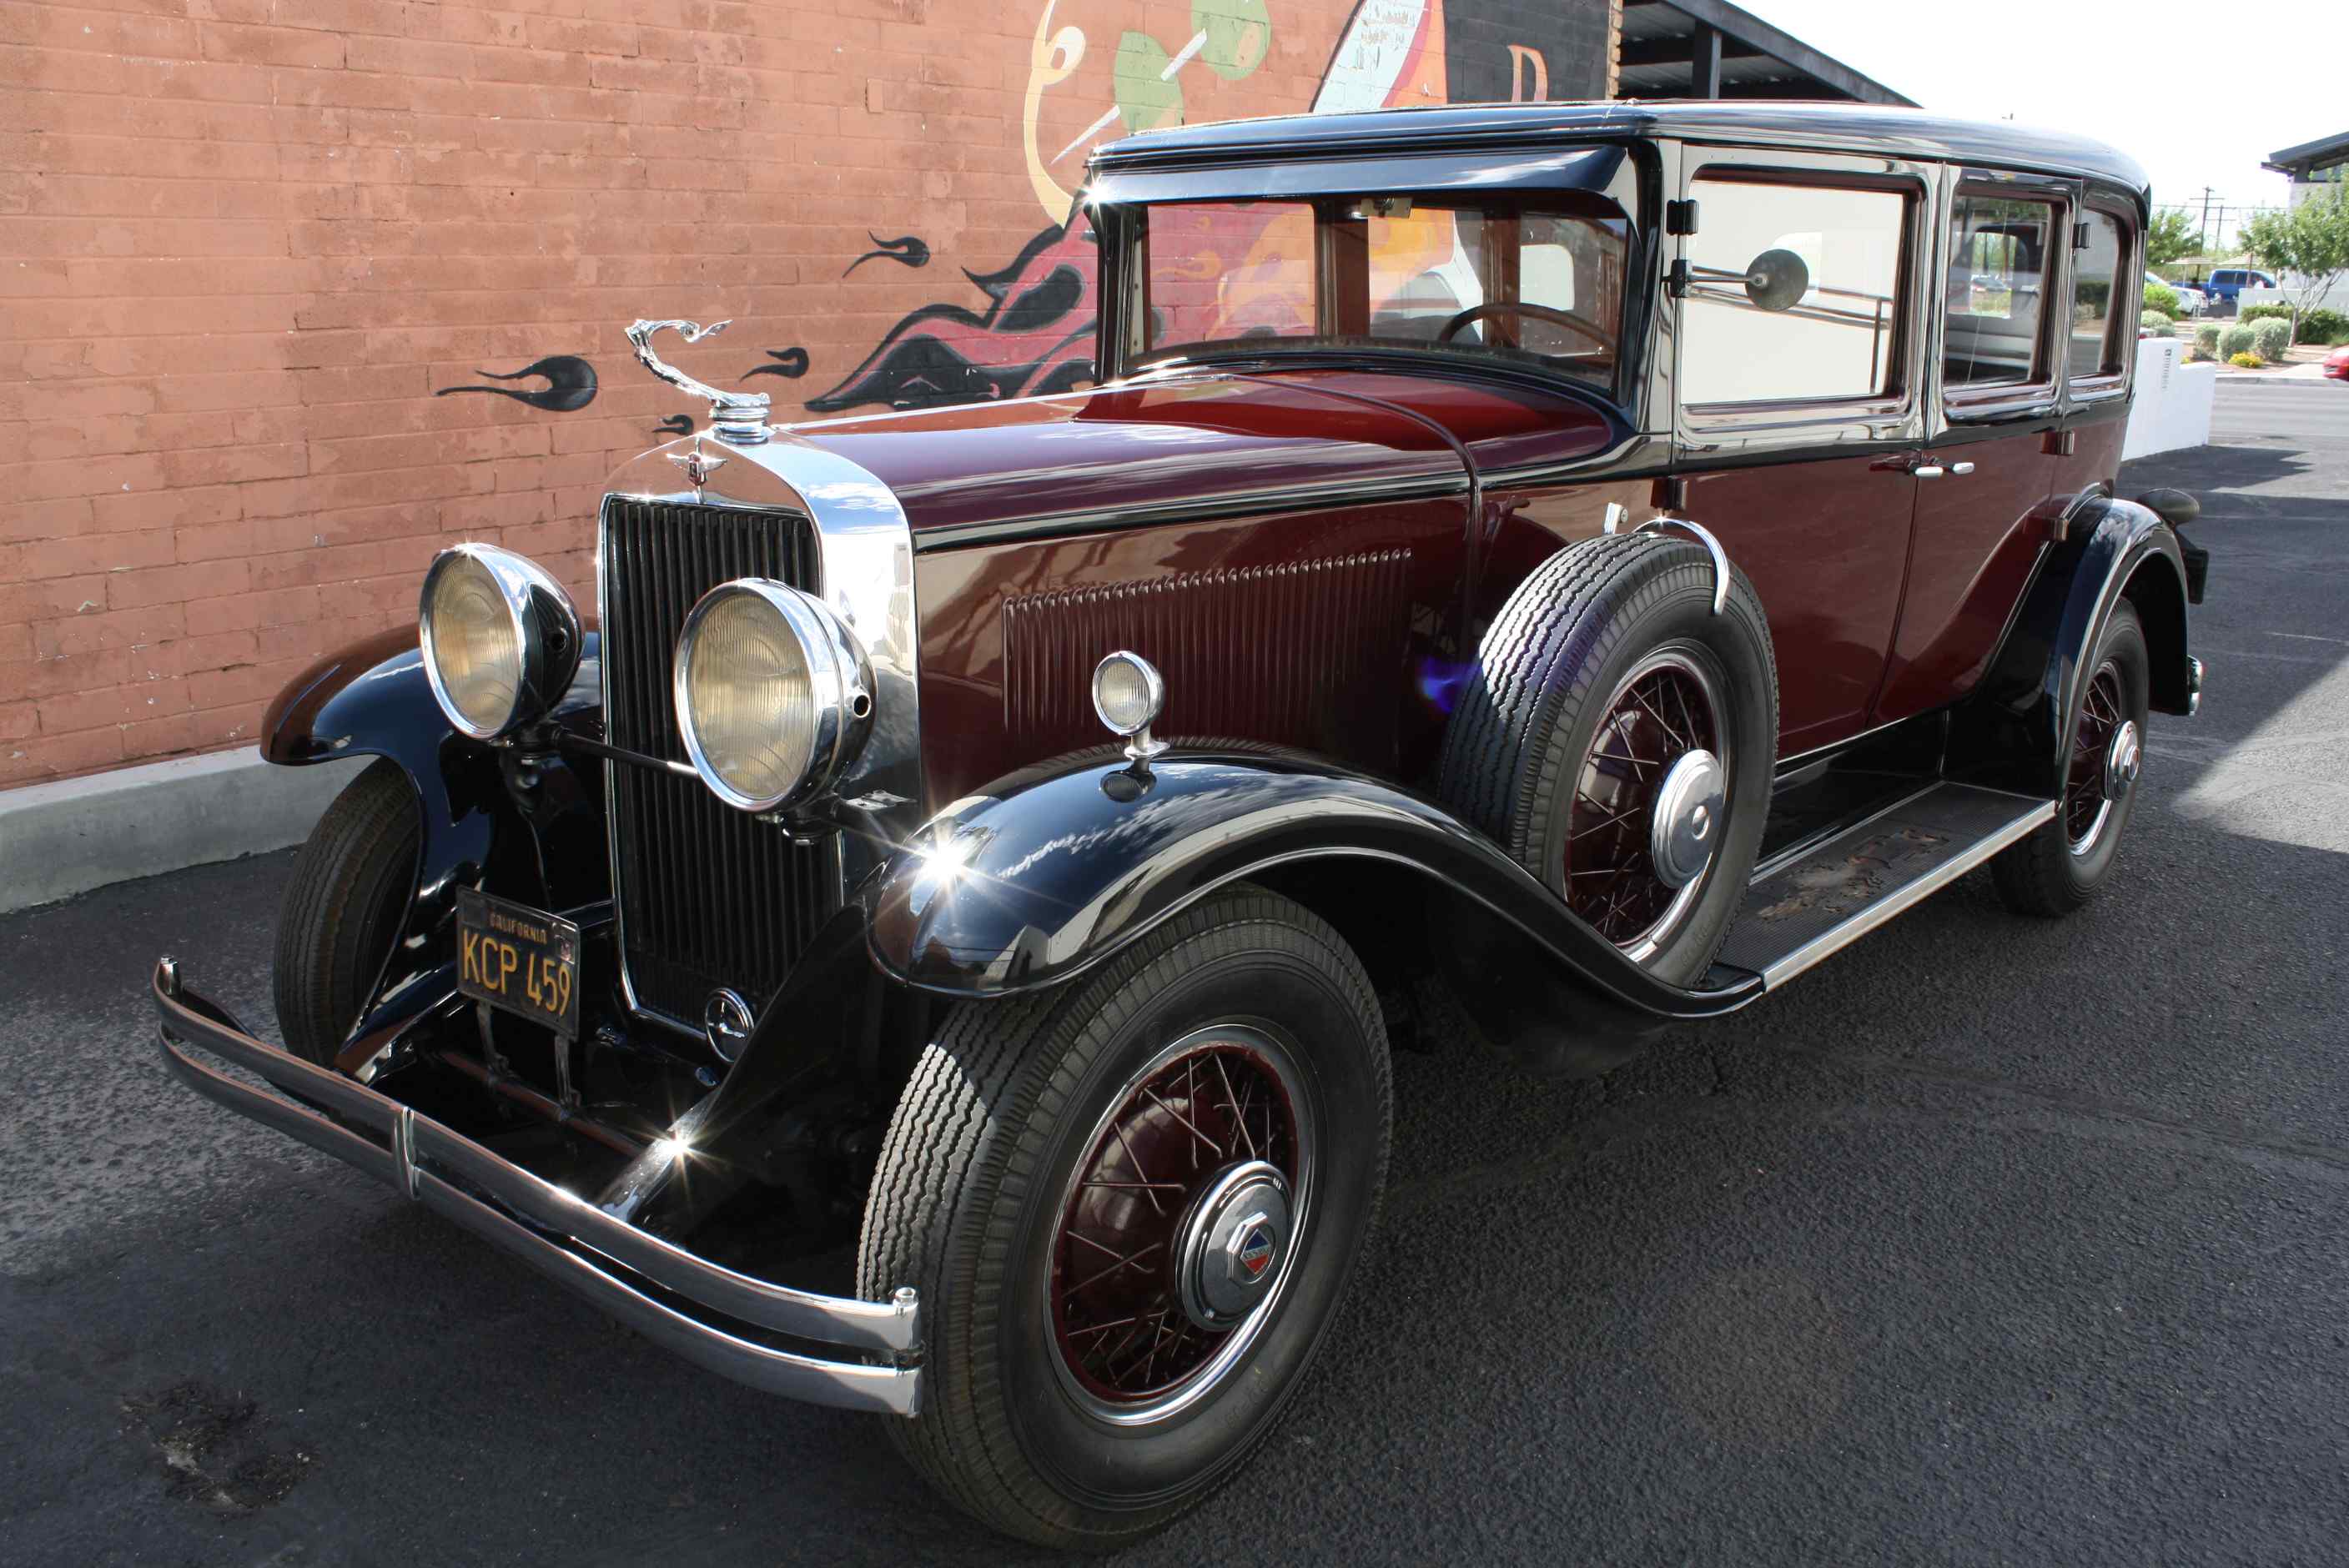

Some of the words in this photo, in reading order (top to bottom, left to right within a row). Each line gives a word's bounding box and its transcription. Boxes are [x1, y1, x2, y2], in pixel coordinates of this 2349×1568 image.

[490, 912, 548, 944] CALIFORNIA
[463, 928, 517, 994] KCP
[527, 952, 571, 1017] 459
